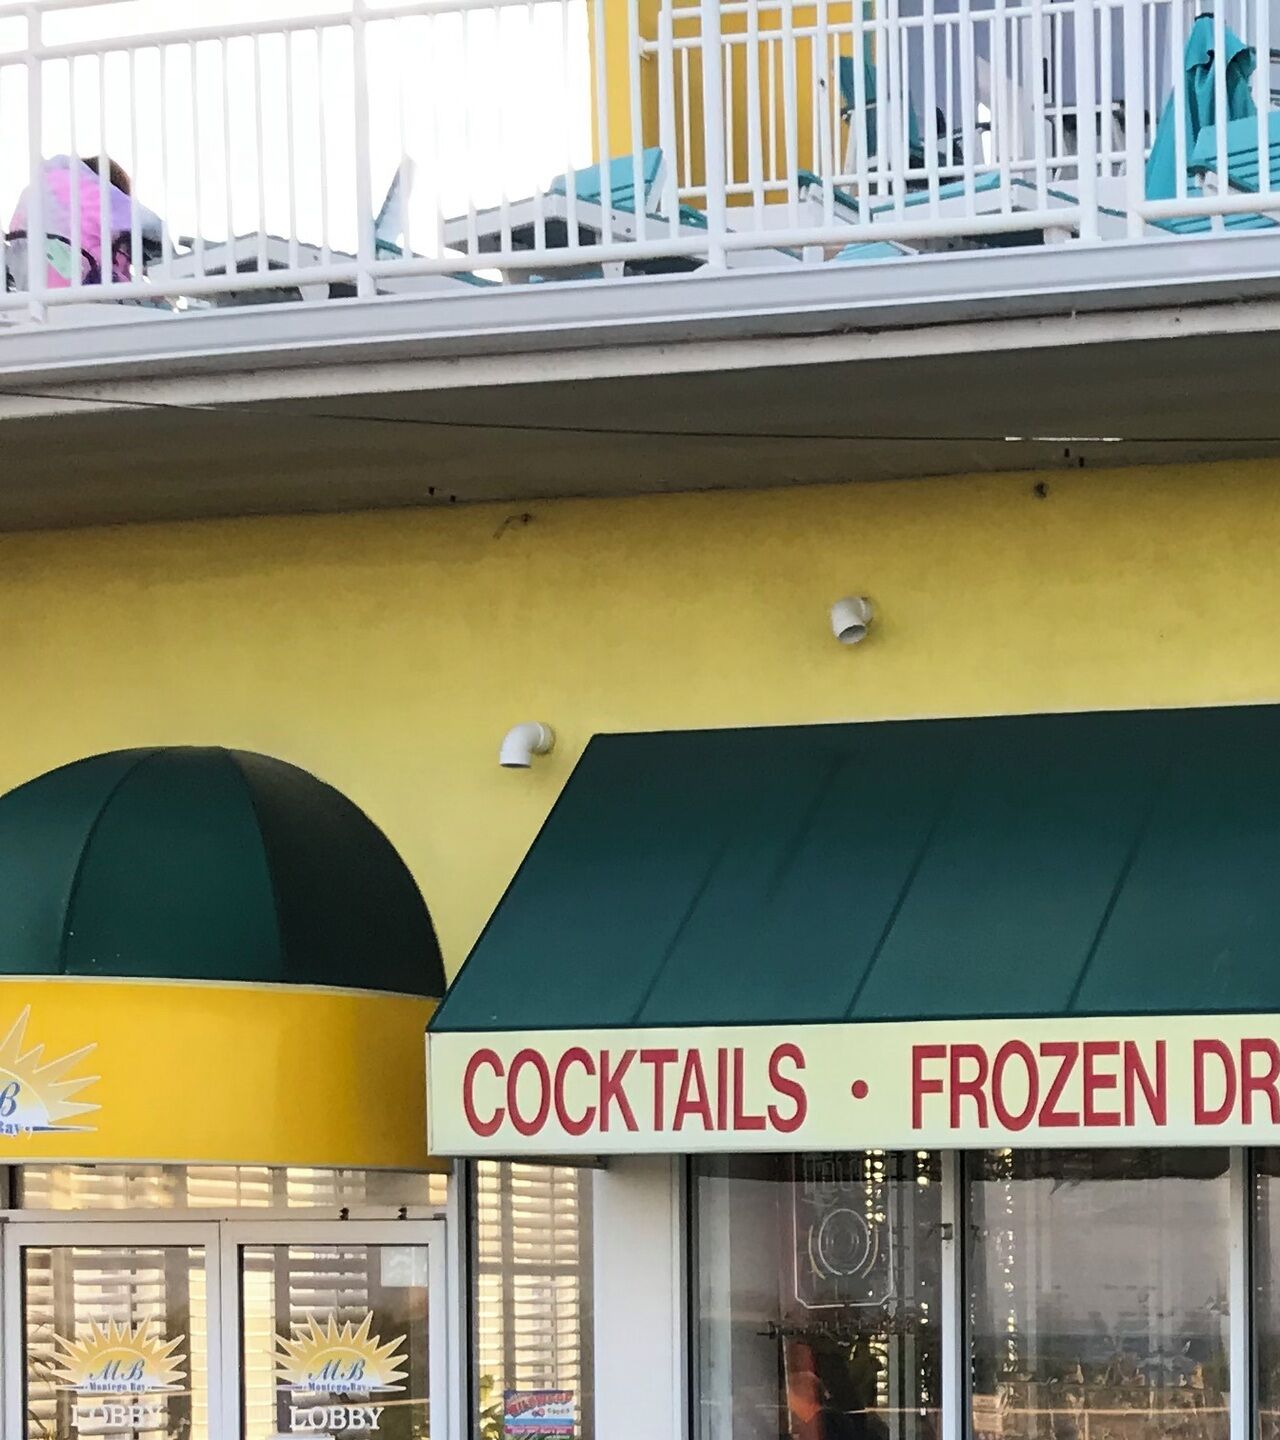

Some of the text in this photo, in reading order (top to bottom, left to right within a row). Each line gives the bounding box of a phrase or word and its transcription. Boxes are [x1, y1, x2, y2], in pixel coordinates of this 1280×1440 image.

[463, 1042, 808, 1137] COCKTAILS
[912, 1039, 1167, 1132] FROZEN
[89, 1359, 145, 1381] MB
[308, 1358, 366, 1381] MB
[289, 1406, 384, 1430] LOBBY
